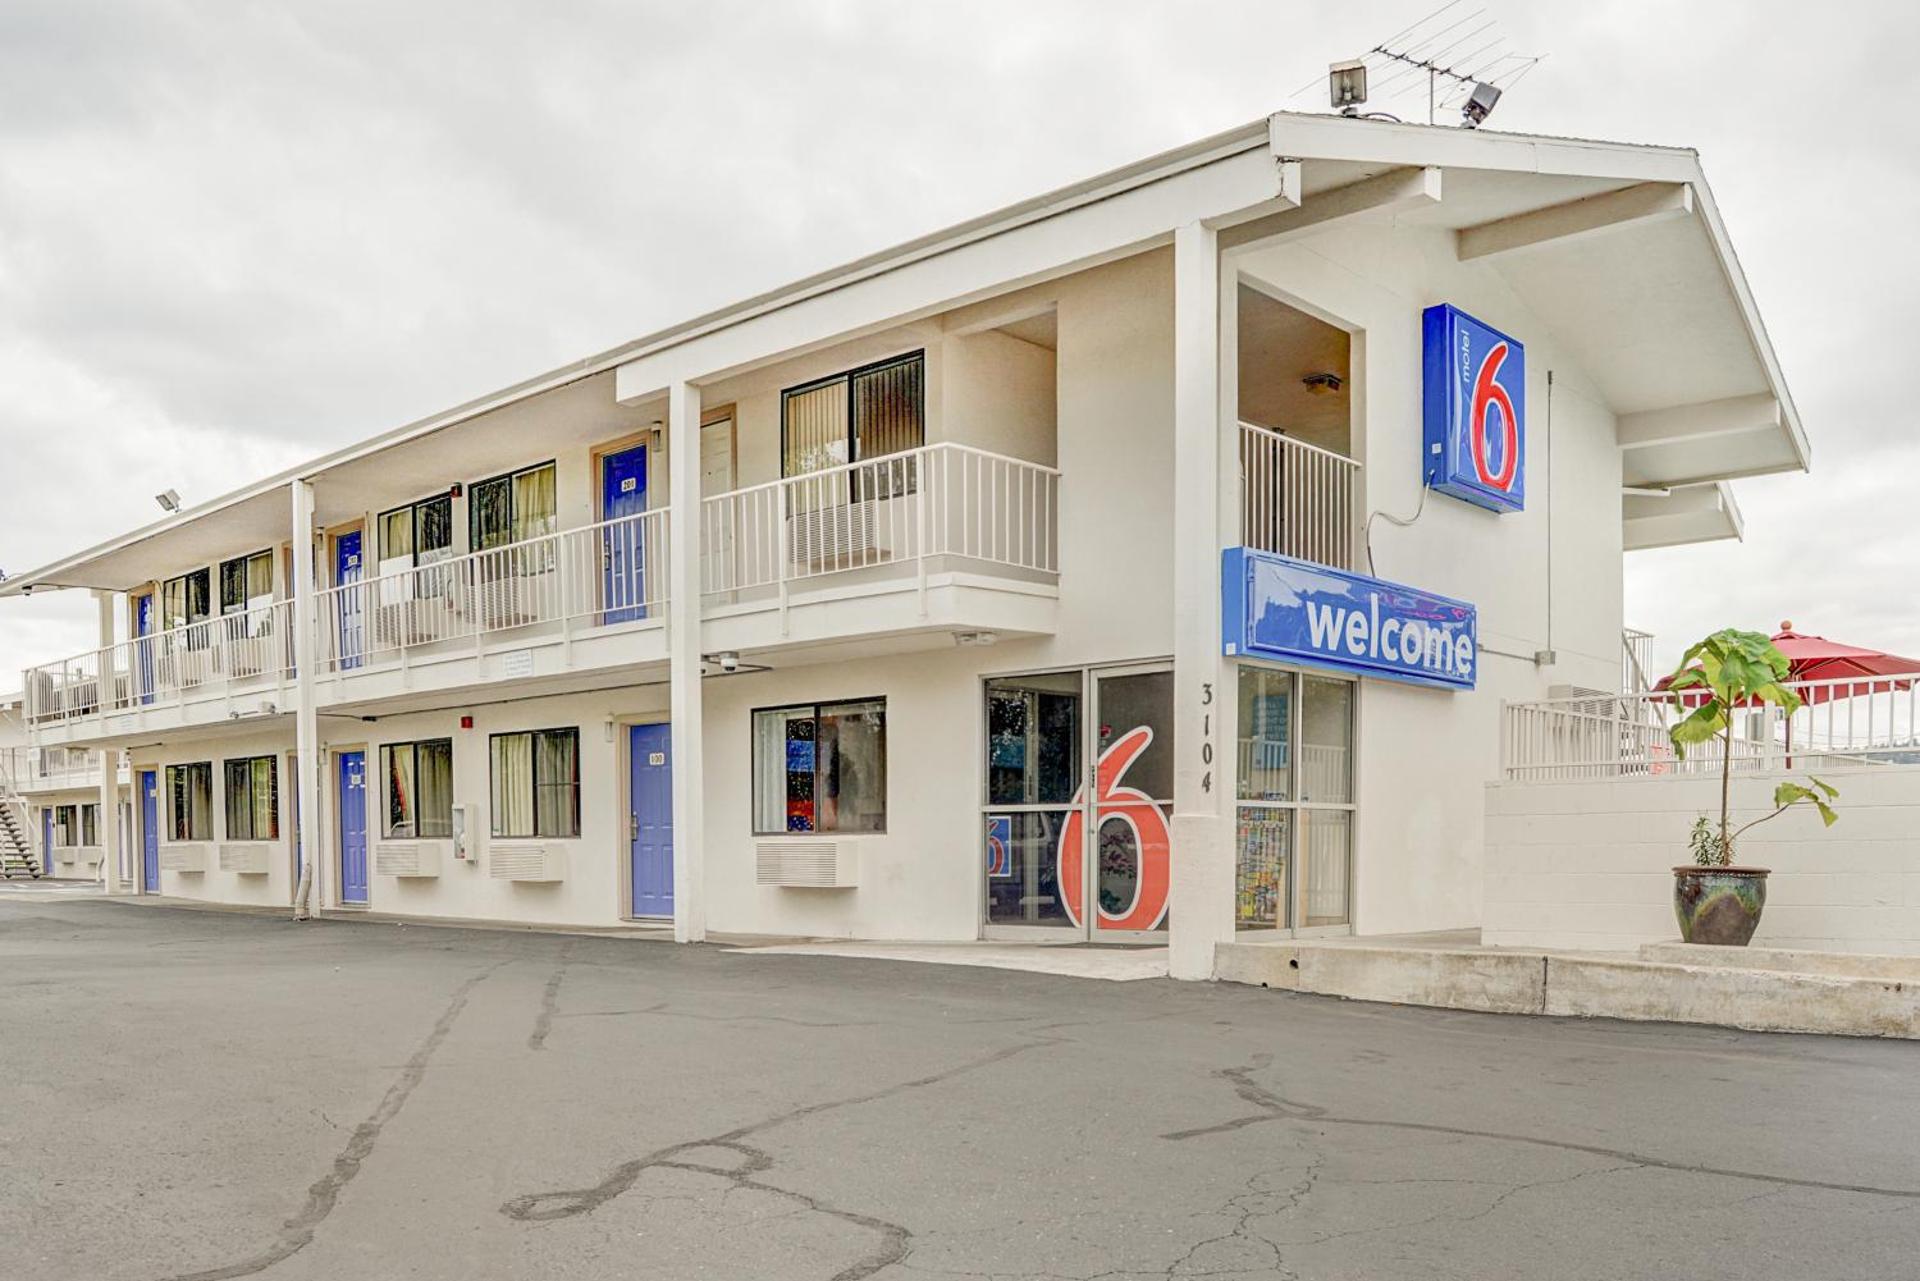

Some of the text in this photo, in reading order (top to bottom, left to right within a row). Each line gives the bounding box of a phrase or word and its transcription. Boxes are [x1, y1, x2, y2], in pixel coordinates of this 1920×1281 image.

[1461, 330, 1470, 383] motel
[1470, 341, 1519, 492] 6
[1306, 592, 1473, 675] welcome
[1202, 683, 1213, 793] 3104
[1057, 724, 1170, 930] 6
